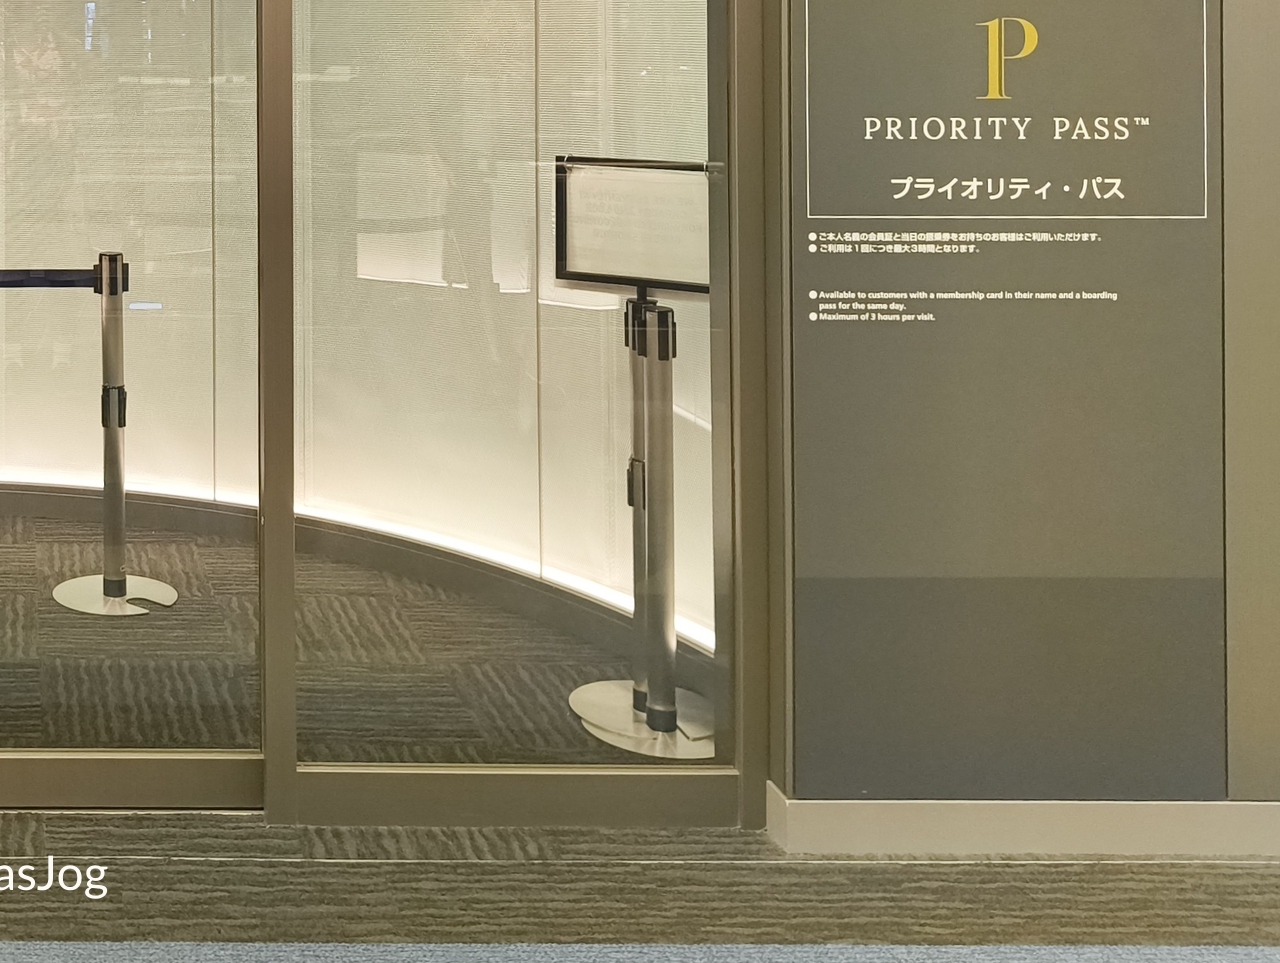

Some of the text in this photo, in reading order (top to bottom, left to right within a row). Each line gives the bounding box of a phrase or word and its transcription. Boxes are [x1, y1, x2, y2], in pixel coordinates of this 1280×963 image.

[864, 117, 1032, 140] PRIORITY
[890, 176, 1125, 200] プライオリティ・パス
[819, 291, 856, 299] Available
[909, 291, 928, 299] with
[936, 291, 984, 301] membership
[986, 291, 1003, 299] card
[1014, 291, 1033, 299] their
[1058, 291, 1073, 299] and
[1082, 291, 1118, 301] boarding
[819, 303, 836, 311] pass
[838, 302, 851, 310] for
[852, 302, 866, 310] the
[889, 302, 907, 311] day.
[819, 313, 859, 321] Maximum
[860, 313, 869, 321] of
[877, 313, 900, 321] hours
[902, 314, 915, 322] per
[916, 313, 936, 321] visit.
